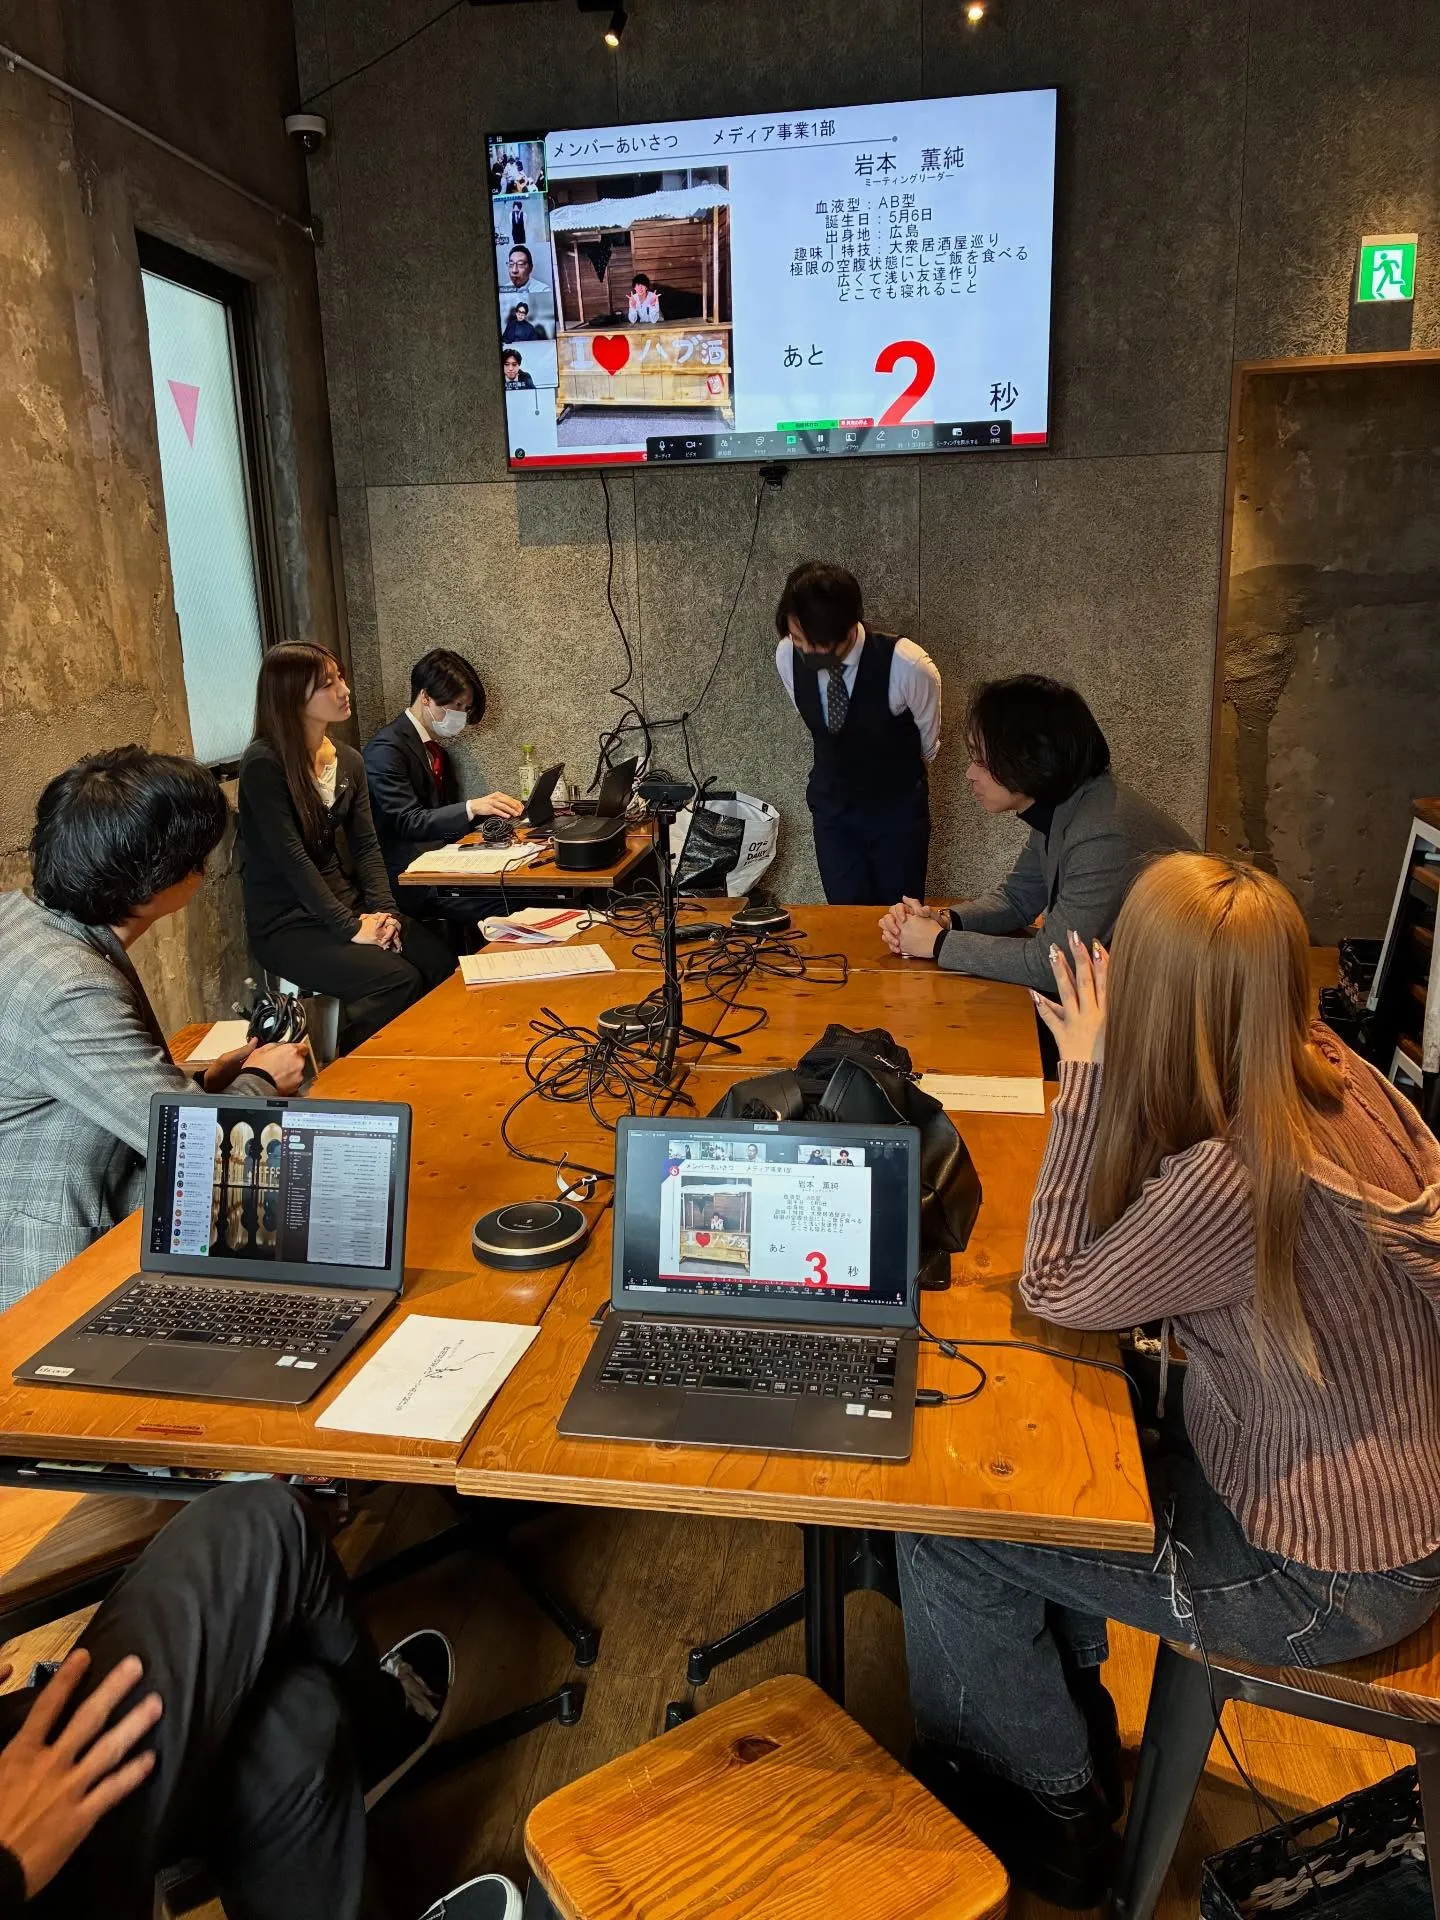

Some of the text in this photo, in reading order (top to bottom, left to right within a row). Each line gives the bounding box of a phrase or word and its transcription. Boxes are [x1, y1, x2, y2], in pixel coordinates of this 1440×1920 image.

[553, 119, 836, 158] メンバーあいさつ メディア事業1部
[854, 145, 965, 176] 岩本 薫純
[865, 171, 955, 187] ミーティングリーダー
[837, 265, 976, 288] 広くて浅い友達作り
[838, 282, 977, 302] どこでも寝れること
[783, 344, 824, 368] あと
[874, 340, 936, 425] 2
[989, 381, 1019, 414] 秒
[769, 1243, 786, 1253] あと
[804, 1251, 828, 1287] 3
[847, 1265, 859, 1277] 秒
